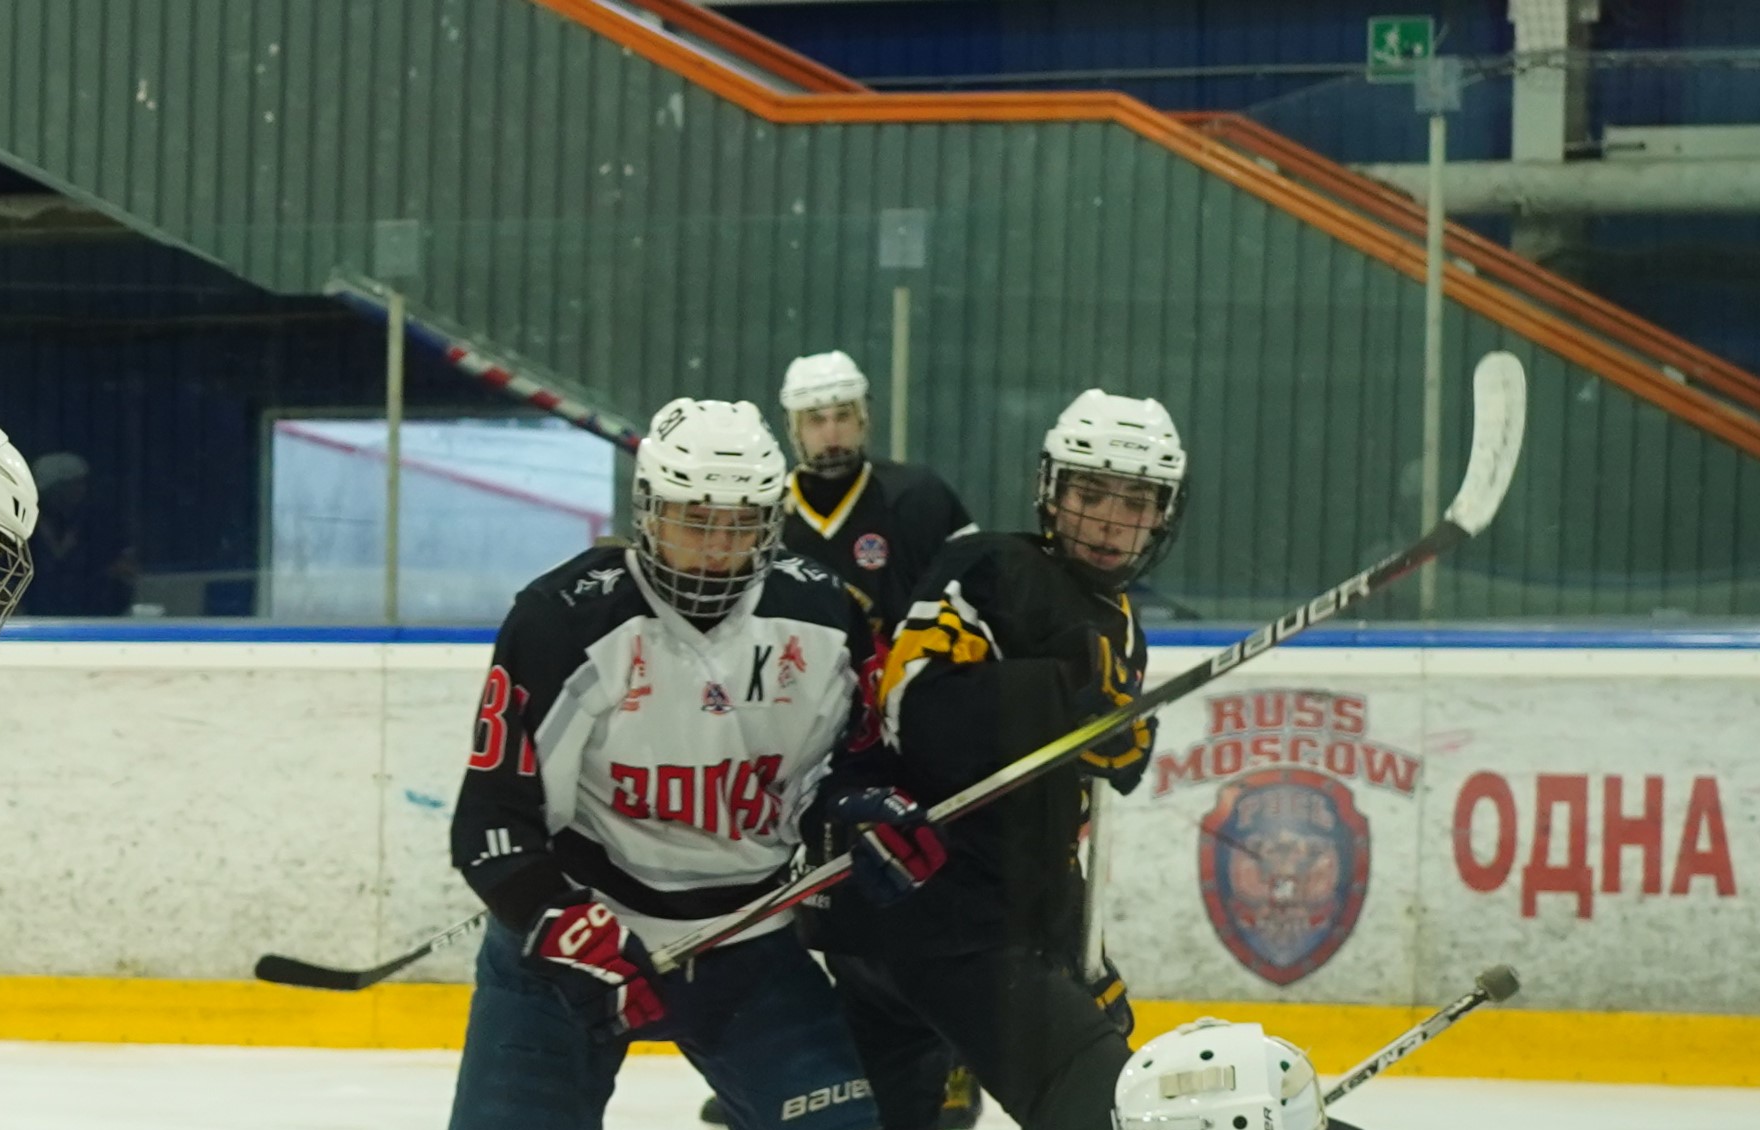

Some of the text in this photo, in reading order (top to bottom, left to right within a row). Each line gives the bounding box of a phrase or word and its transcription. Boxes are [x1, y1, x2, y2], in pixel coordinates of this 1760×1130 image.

[1109, 439, 1150, 452] CCM
[1210, 688, 1366, 737] RUSS
[1152, 735, 1422, 796] MOSCOW
[1452, 770, 1737, 920] ОДНА
[558, 902, 618, 957] CC
[781, 1078, 874, 1122] BAUE
